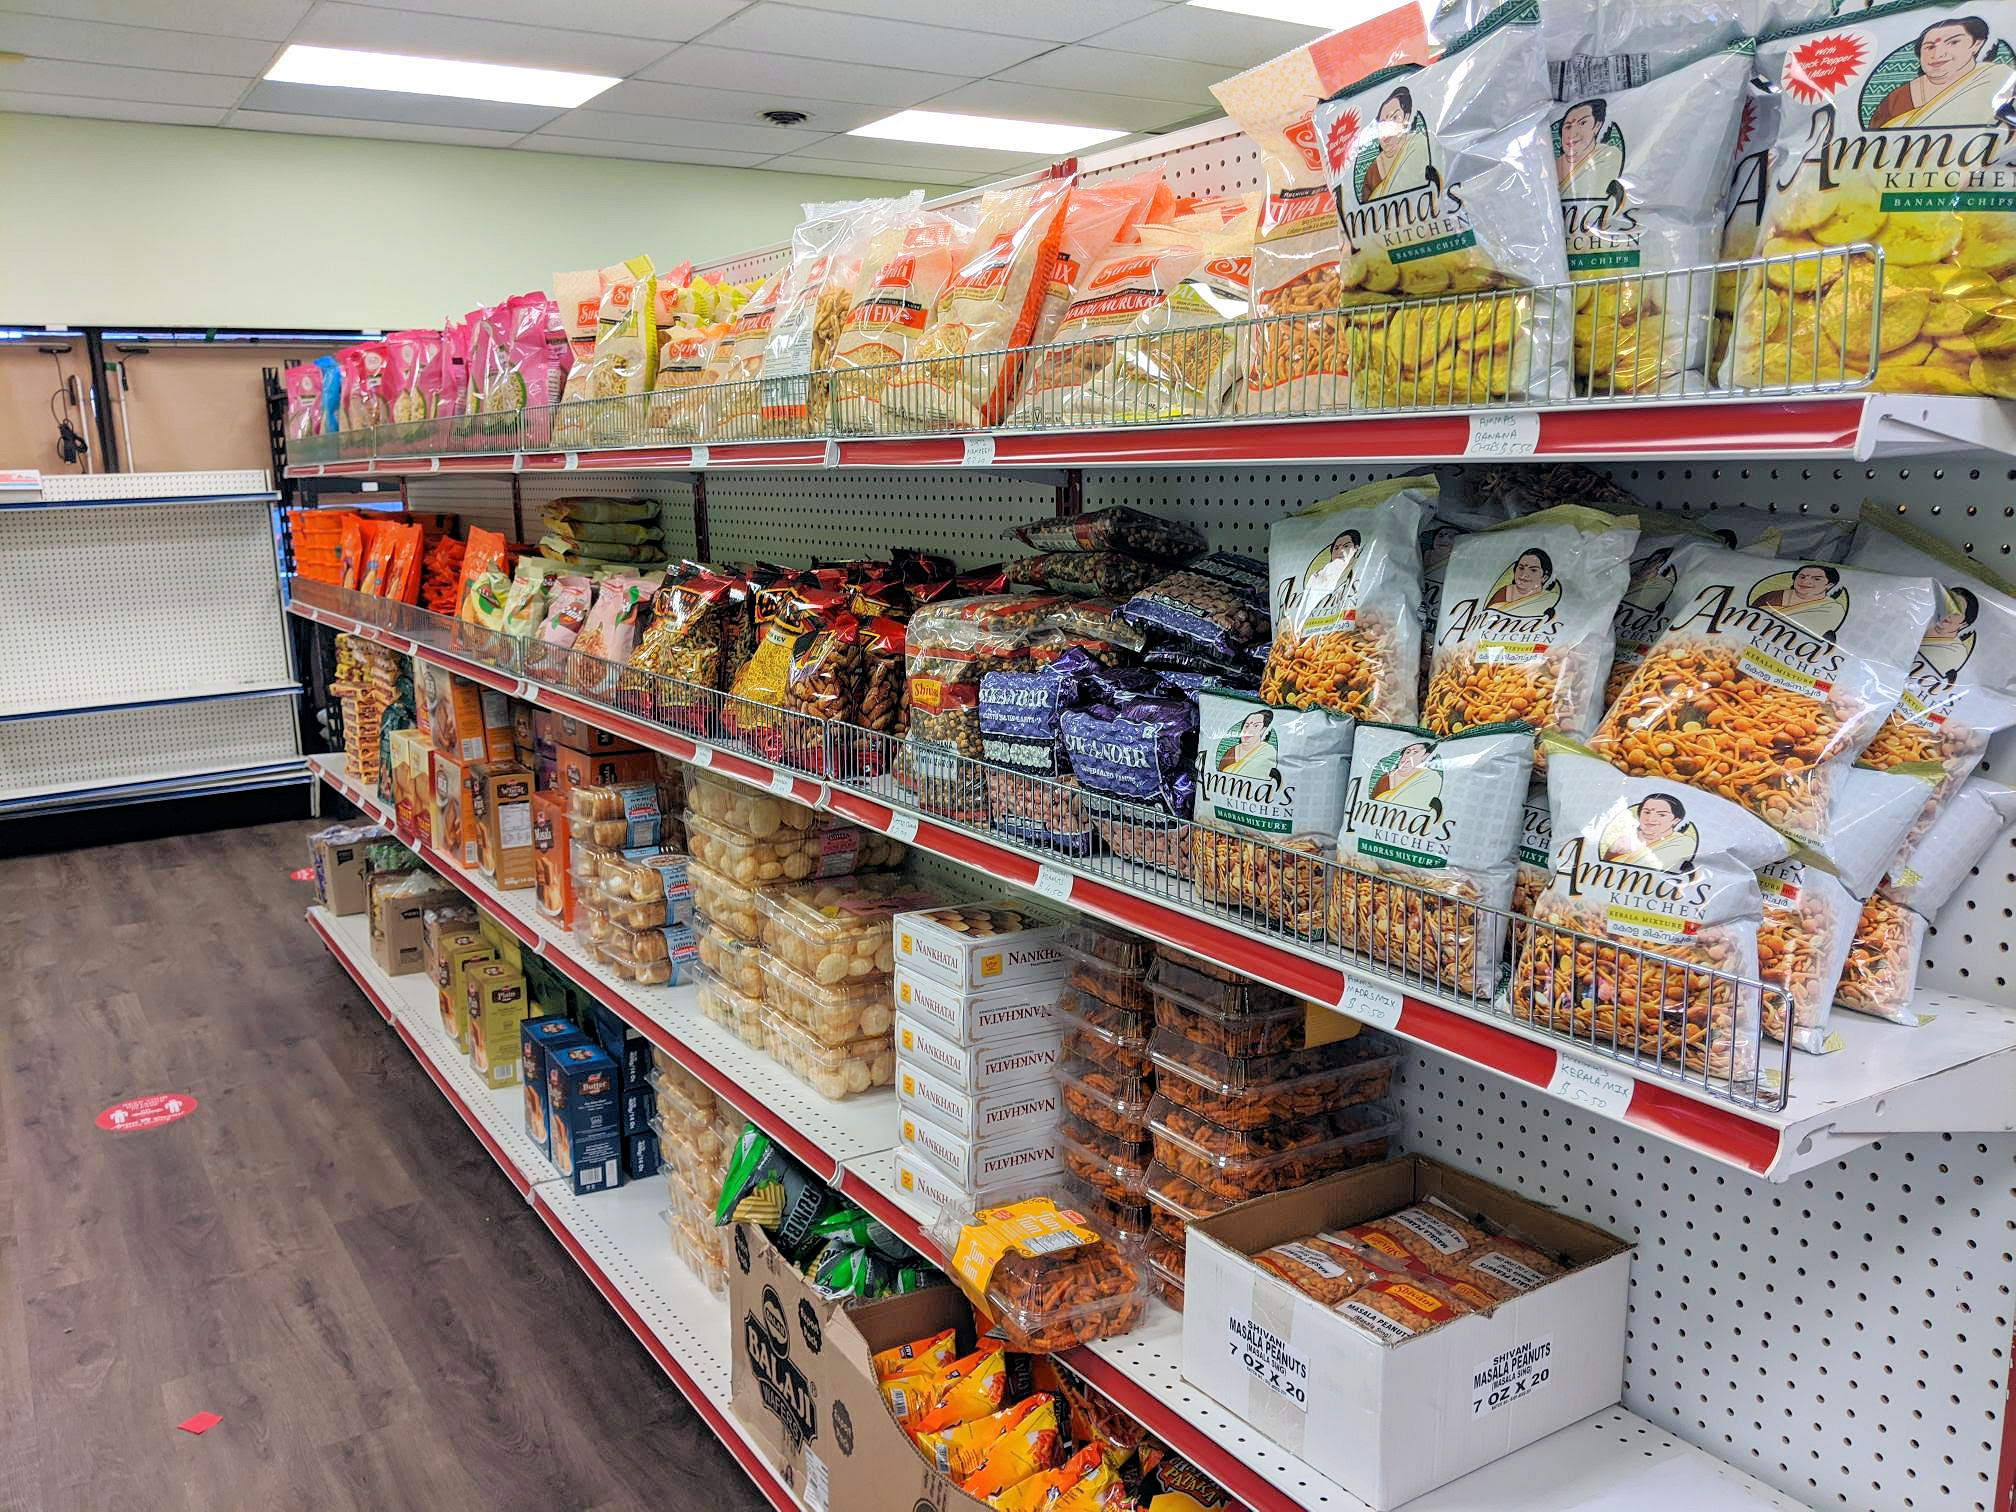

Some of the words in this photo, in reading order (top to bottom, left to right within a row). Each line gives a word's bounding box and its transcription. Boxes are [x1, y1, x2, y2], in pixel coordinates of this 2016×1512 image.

[1894, 197, 1961, 207] BANANA
[1966, 197, 2014, 207] CHIPS
[1383, 212, 1471, 247] KITCHEN
[1475, 429, 1518, 442] BANANA
[1438, 598, 1564, 647] Amma's
[1480, 630, 1555, 644] KITCHEN
[1668, 584, 1845, 673] Amma's
[1745, 650, 1774, 671] KERALA
[1775, 667, 1814, 686] MIXTURE
[1750, 634, 1838, 683] KITCHEN
[1196, 749, 1297, 806] Amma's
[1216, 809, 1247, 826] MADRAS
[1247, 816, 1289, 832] MIXTURE
[1225, 797, 1295, 818] KITCHEN
[1345, 775, 1457, 842] Amma's
[1360, 842, 1396, 861] MADRAS
[1395, 849, 1443, 868] MIXTURE
[1373, 828, 1452, 856] KITCHEN
[1552, 837, 1712, 906] Amma's
[1609, 891, 1707, 921] KITCHEN
[1609, 910, 1640, 921] KERALA
[1641, 916, 1684, 930] MIXTURE
[915, 938, 959, 970] NANKHATAI
[1007, 948, 1063, 966] NANKHA
[914, 987, 956, 1022] NANKHATAI
[979, 1003, 1053, 1028] NANKHATAI
[917, 1035, 962, 1072] NANKHATAI
[985, 1049, 1056, 1076] NANKHATAI
[582, 1081, 608, 1091] Butter
[1560, 1063, 1601, 1087] KERALA
[1602, 1081, 1630, 1099] MIX
[918, 1082, 964, 1119] NANKHATAI
[986, 1097, 1056, 1124] NANKHATAI
[917, 1128, 961, 1164] NANKHATAI
[984, 1146, 1056, 1173] NANKHATAI
[917, 1177, 948, 1207] NANKH
[1347, 1303, 1378, 1322] MASALA
[1229, 1316, 1264, 1352] MASALA
[1265, 1340, 1307, 1379] PEANUTS
[1247, 1320, 1285, 1351] SHIVANI
[1473, 1360, 1510, 1390] MASALA
[1511, 1341, 1551, 1372] PEANUTS
[1492, 1341, 1532, 1366] SHIVANI
[747, 1325, 813, 1428] BALAJI
[1229, 1341, 1239, 1355] 7
[1243, 1353, 1265, 1377] OZ
[1269, 1369, 1280, 1387] X
[1285, 1381, 1305, 1403] 20
[1473, 1398, 1483, 1414] 7
[1487, 1385, 1511, 1407] OZ
[1514, 1378, 1527, 1395] X
[1530, 1368, 1550, 1387] 20
[762, 1384, 800, 1442] WAFERS
[1163, 1466, 1217, 1502] PATAKA
